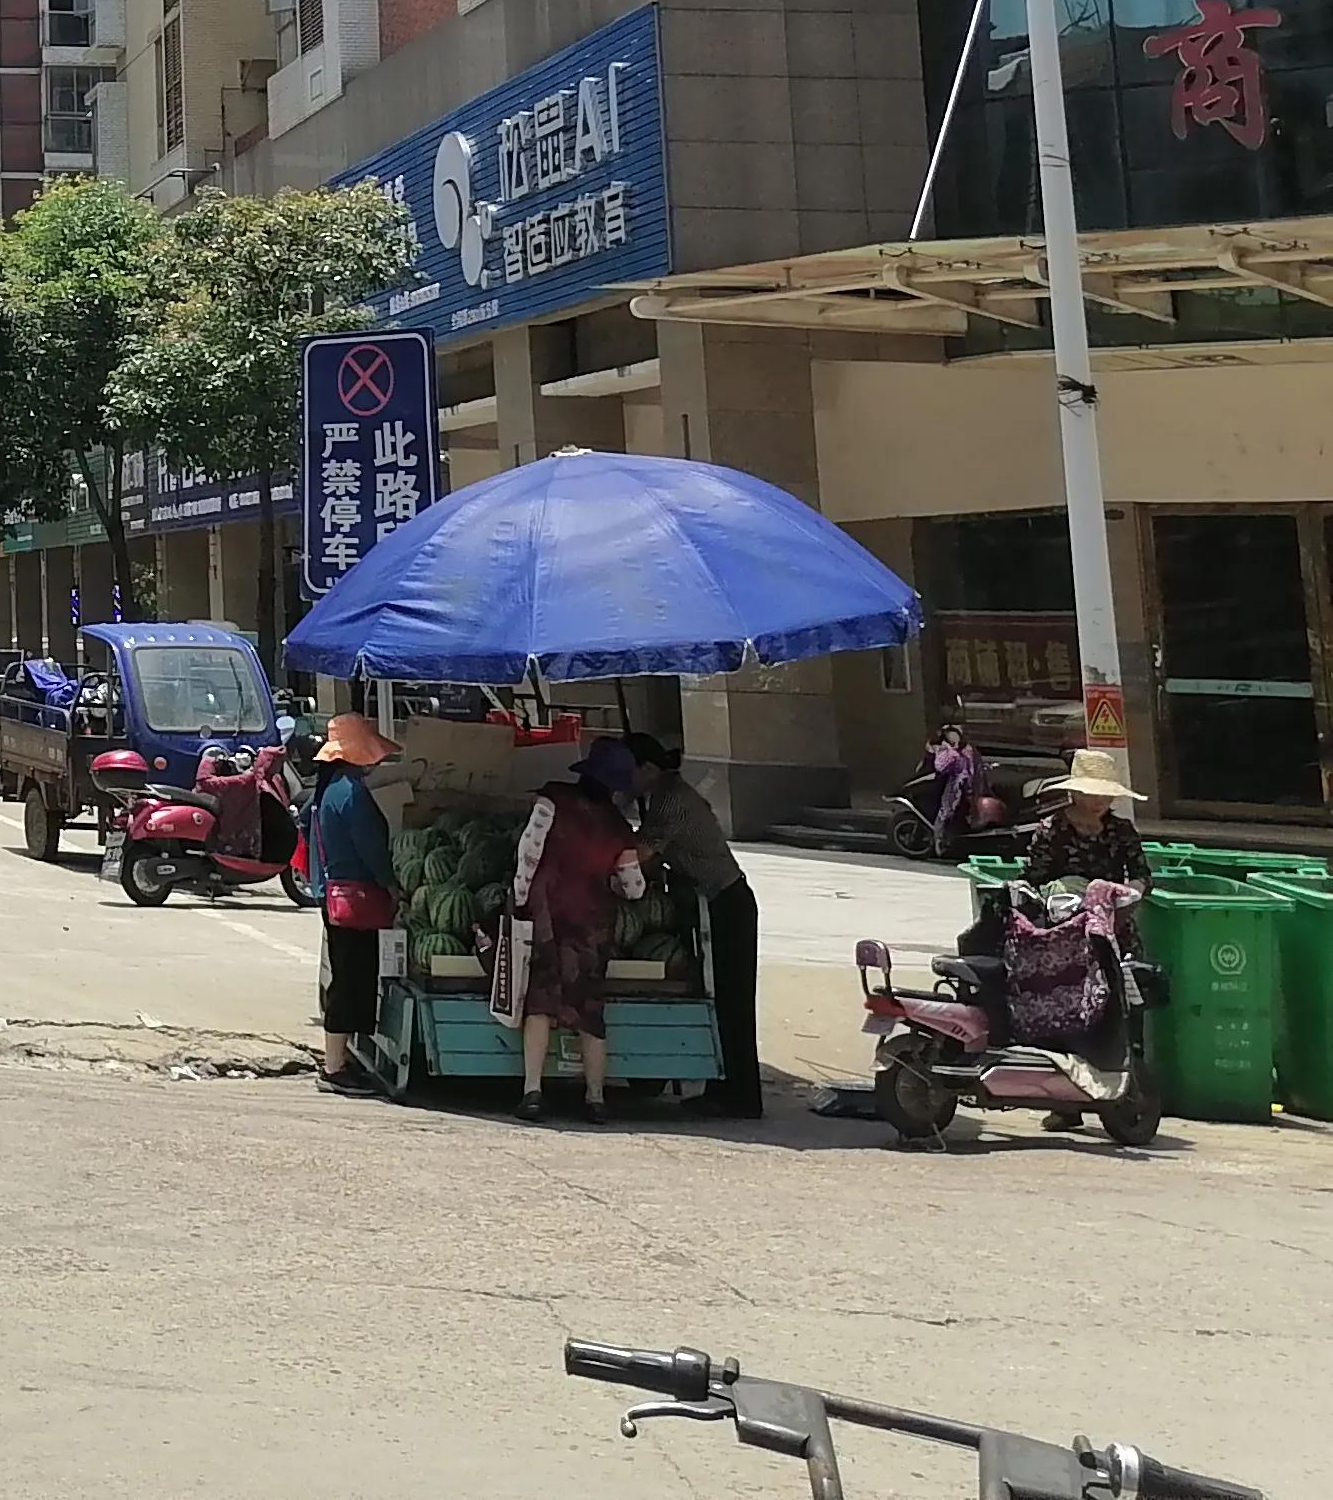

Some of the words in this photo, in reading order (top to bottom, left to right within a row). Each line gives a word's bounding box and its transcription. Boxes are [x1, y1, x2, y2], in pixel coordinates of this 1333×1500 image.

[497, 62, 631, 203] 松鼠AI
[503, 184, 625, 284] 智适应教育
[319, 422, 362, 571] 严禁停车
